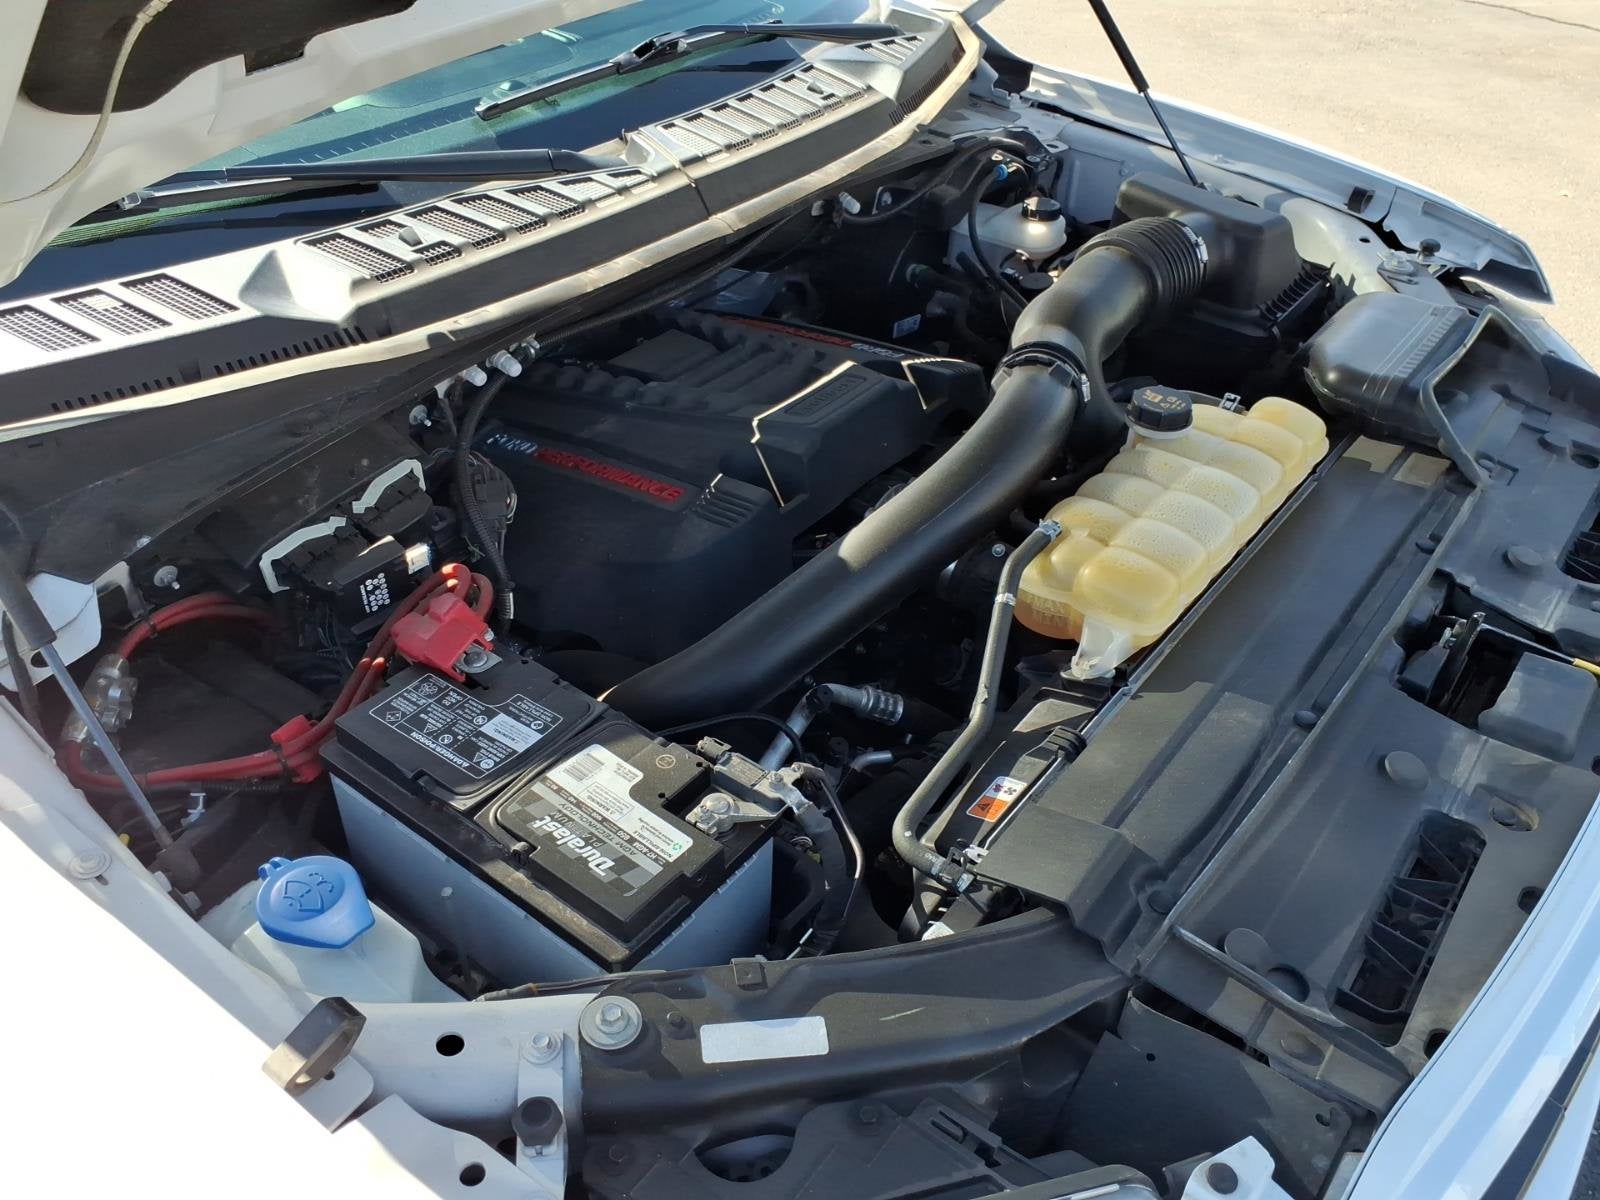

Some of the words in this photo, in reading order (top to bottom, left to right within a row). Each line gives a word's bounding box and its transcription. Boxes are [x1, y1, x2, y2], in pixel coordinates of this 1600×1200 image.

[560, 803, 616, 842] TECHNOLOGY
[532, 815, 615, 876] Duralast
[615, 841, 637, 856] AGM
